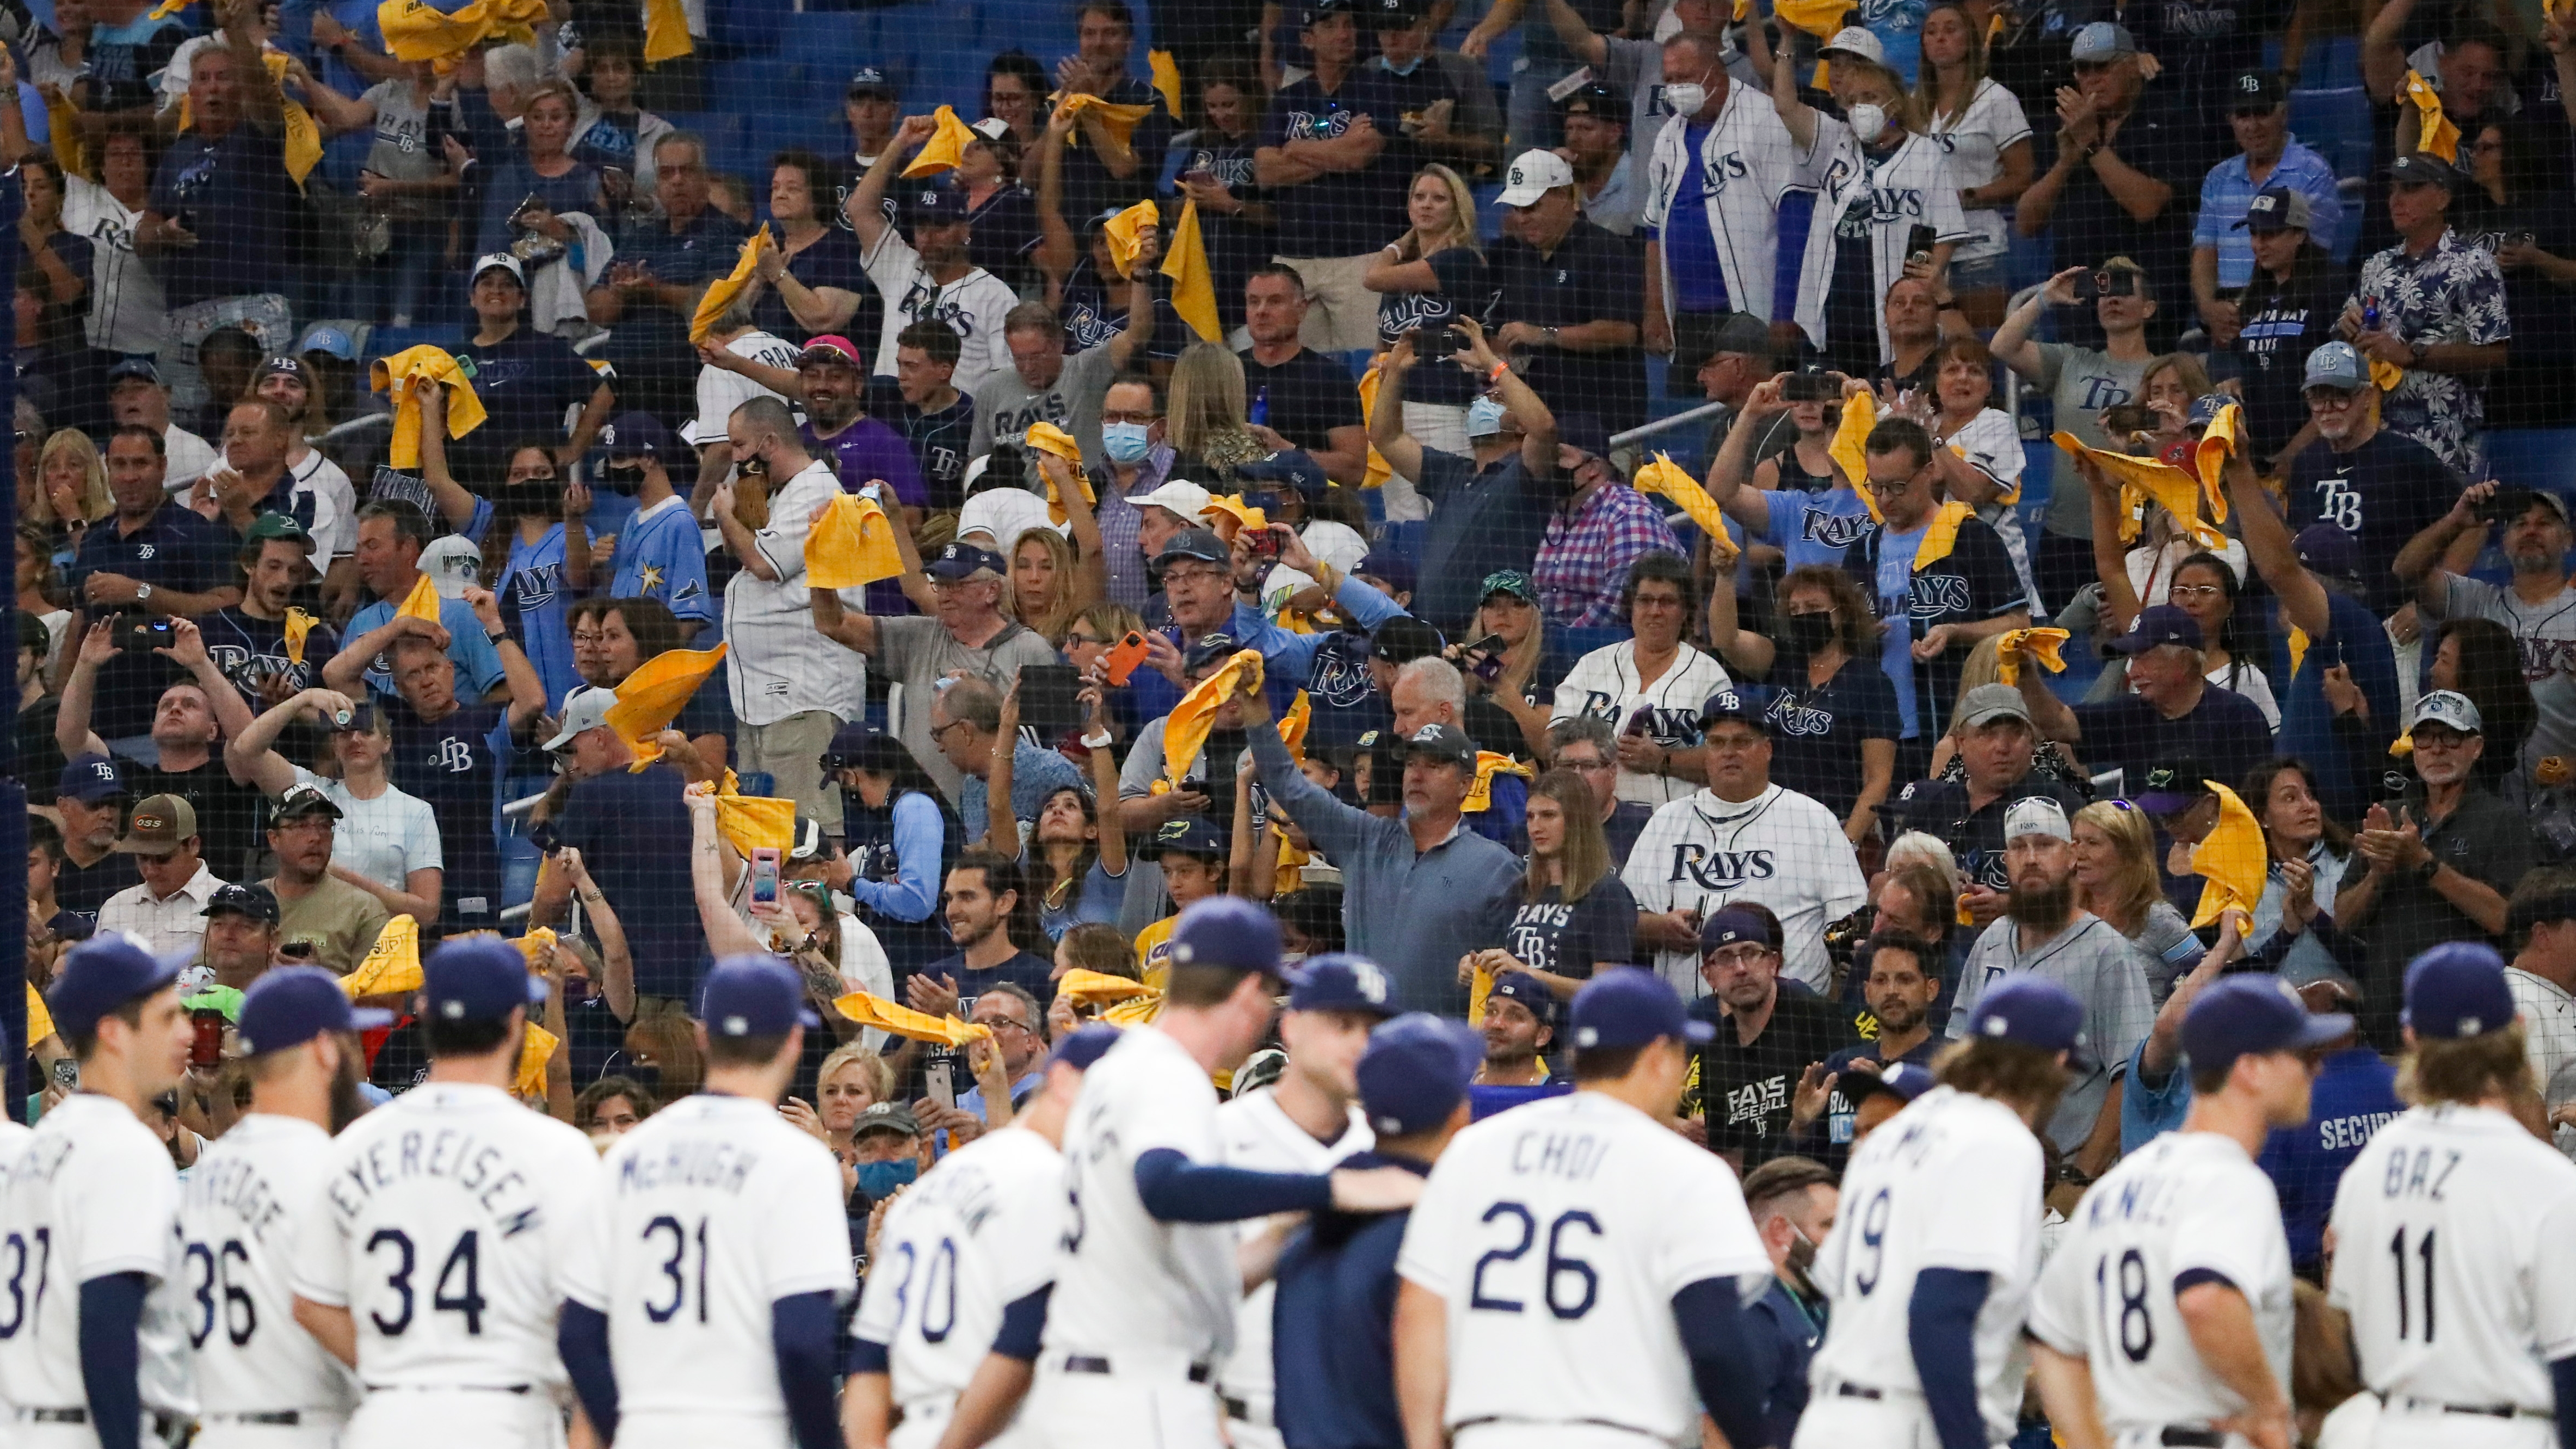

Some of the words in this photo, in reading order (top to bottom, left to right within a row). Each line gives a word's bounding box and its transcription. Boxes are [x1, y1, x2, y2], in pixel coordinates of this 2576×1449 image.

[2239, 75, 2259, 93] TB
[399, 133, 415, 153] TB
[1511, 167, 1523, 186] TB
[921, 190, 937, 205] TB
[2248, 338, 2278, 353] RAYS
[272, 356, 298, 371] TB
[2320, 353, 2336, 371] TB
[2315, 480, 2362, 531] TB
[138, 543, 155, 560] TB
[945, 544, 957, 559] TB
[1718, 691, 1740, 711] TB
[439, 736, 473, 773] TB
[91, 762, 114, 780] TB
[1900, 782, 1916, 800] TB
[1672, 843, 1775, 893] RAYS
[2383, 1146, 2461, 1202] BAZ
[1840, 1186, 1891, 1299] 19
[642, 1214, 709, 1323] 31
[1471, 1199, 1604, 1320] 26
[185, 1239, 257, 1349] 36
[366, 1229, 487, 1336] 34
[895, 1236, 957, 1343] 30
[2389, 1224, 2438, 1345] 11
[2096, 1247, 2155, 1363] 18
